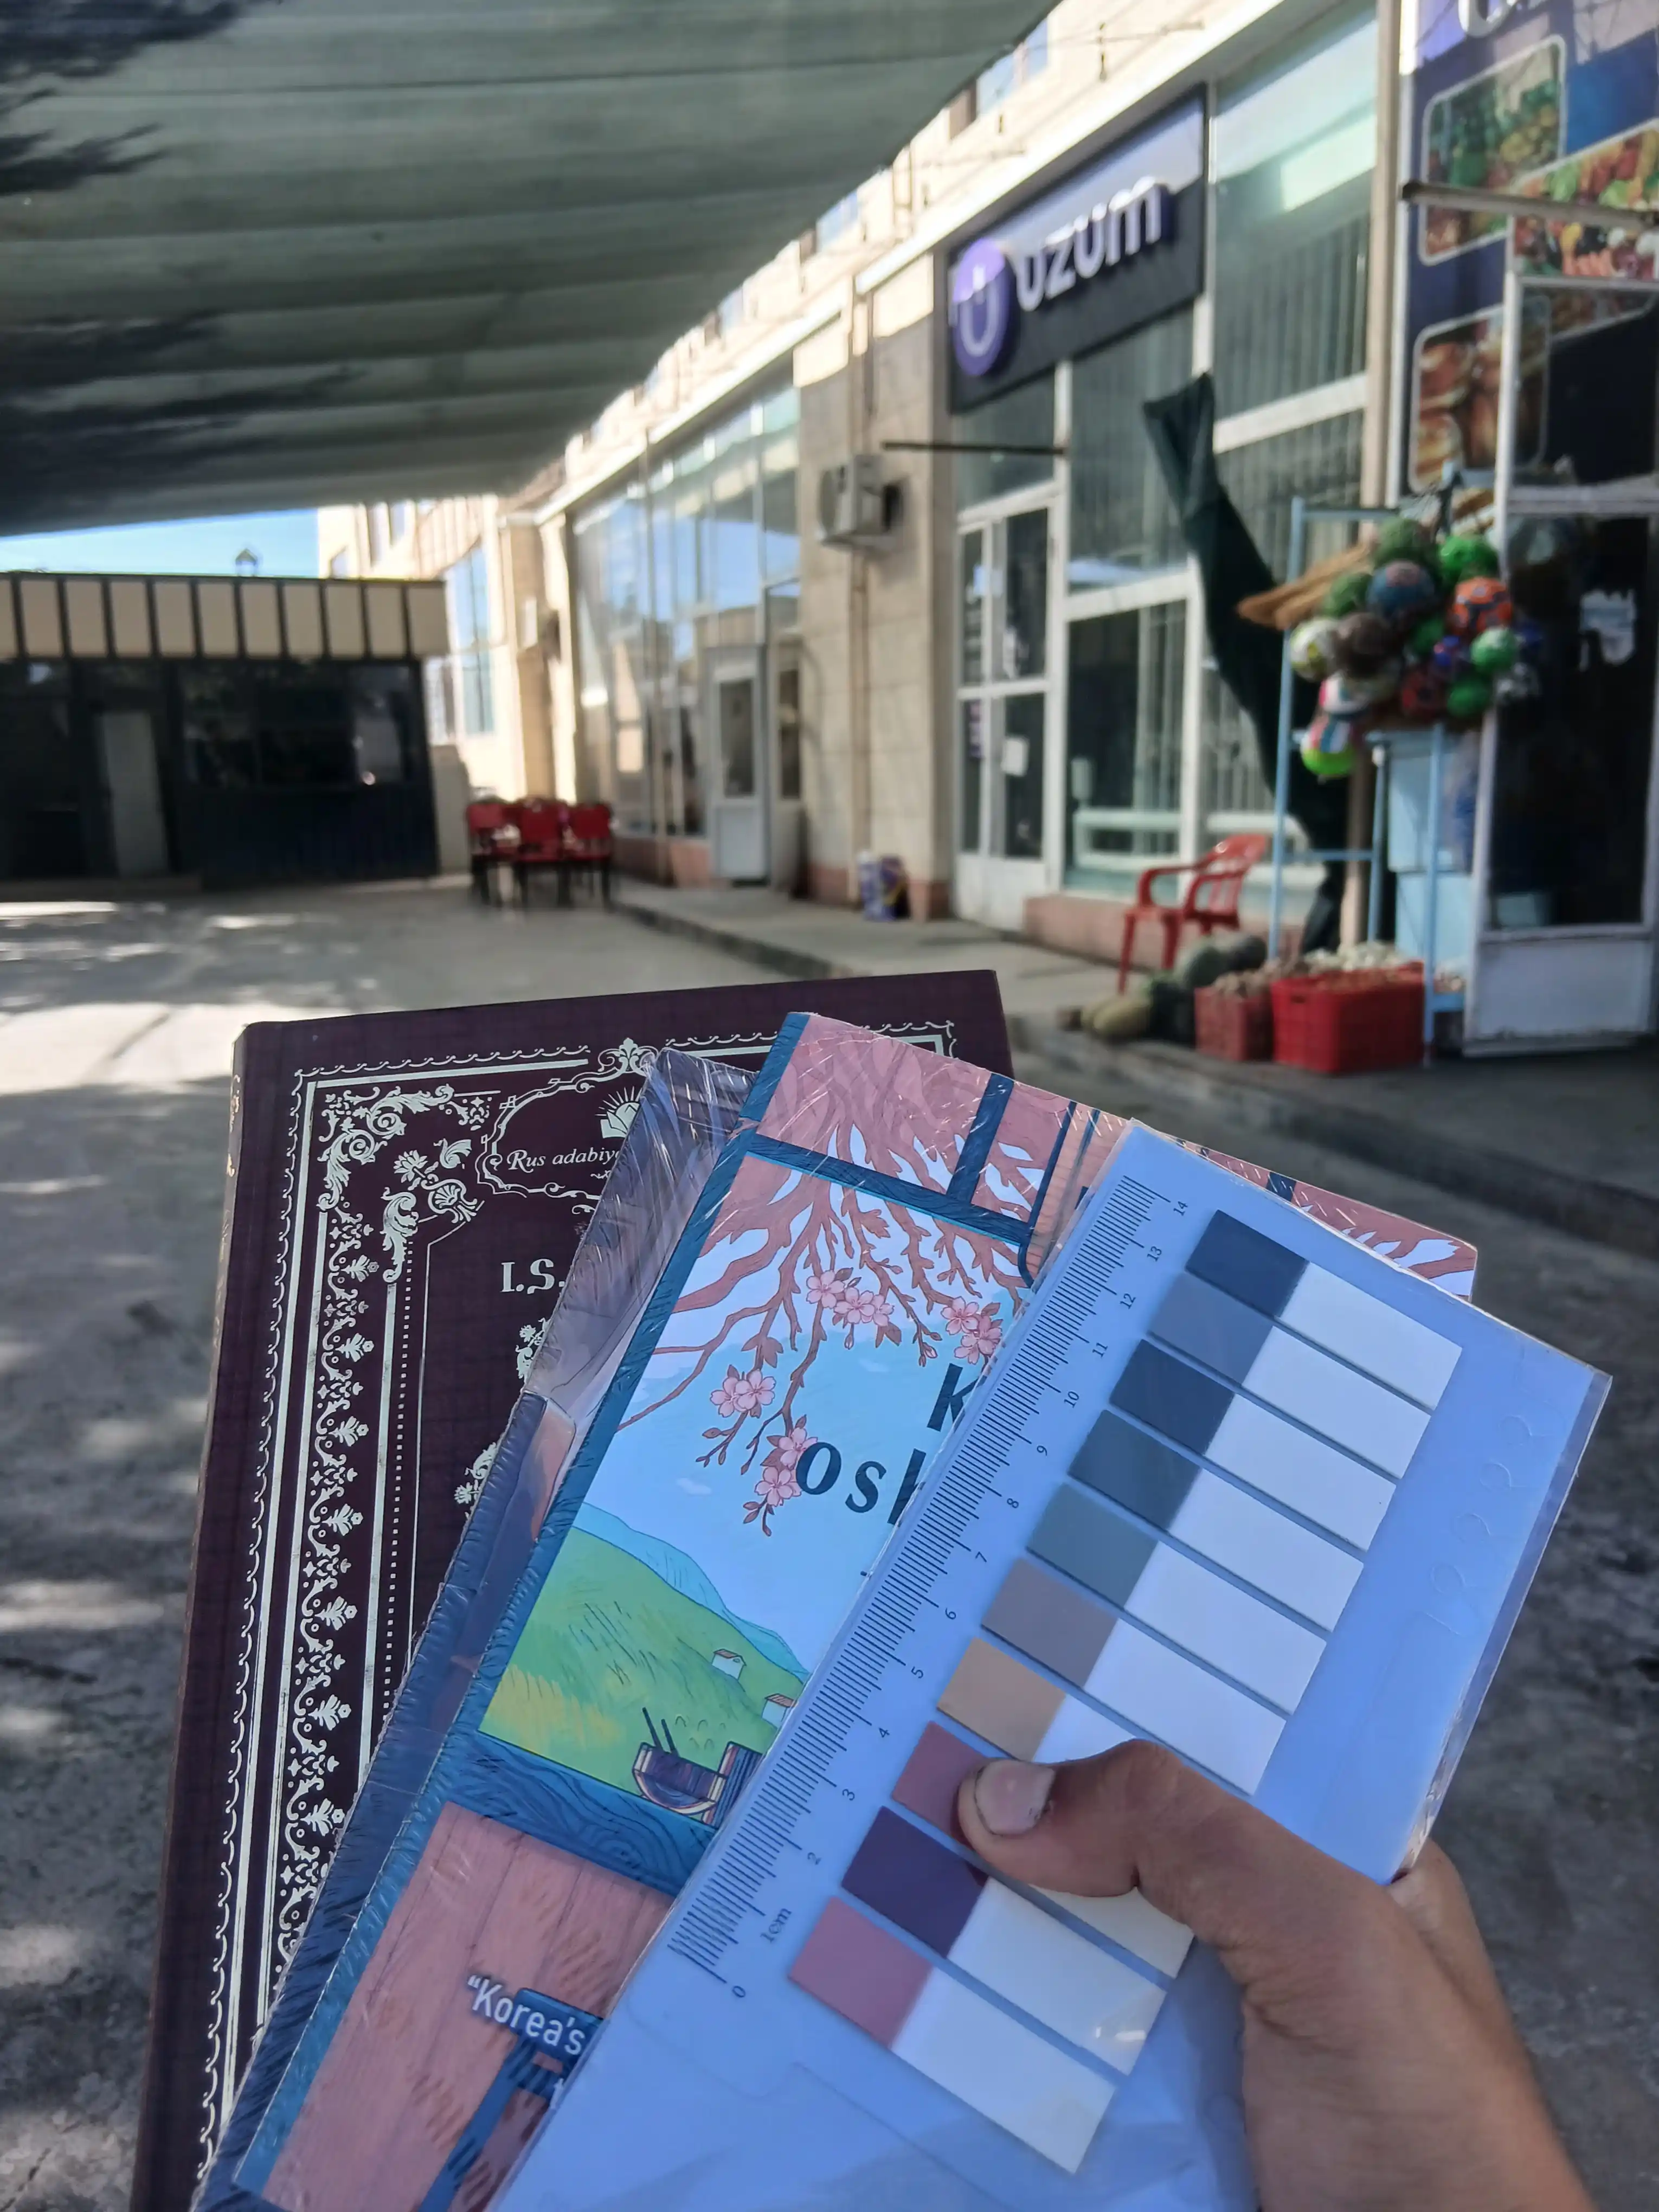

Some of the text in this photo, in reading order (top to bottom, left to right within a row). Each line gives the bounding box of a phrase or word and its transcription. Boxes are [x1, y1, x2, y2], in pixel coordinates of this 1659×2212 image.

[506, 1149, 546, 1174] Rus
[1173, 1200, 1189, 1217] 14
[1147, 1245, 1162, 1262] 13
[1120, 1293, 1136, 1310] 12
[1092, 1342, 1108, 1358] 11
[1064, 1391, 1080, 1408] 10
[1036, 1445, 1048, 1456] 9
[1006, 1498, 1019, 1509] 8
[975, 1552, 987, 1562] 7
[944, 1608, 957, 1620] 6
[911, 1667, 924, 1679] 5
[878, 1727, 890, 1739] 4
[842, 1788, 856, 1801] 3
[807, 1851, 821, 1865] 2
[731, 1985, 746, 1998] 0
